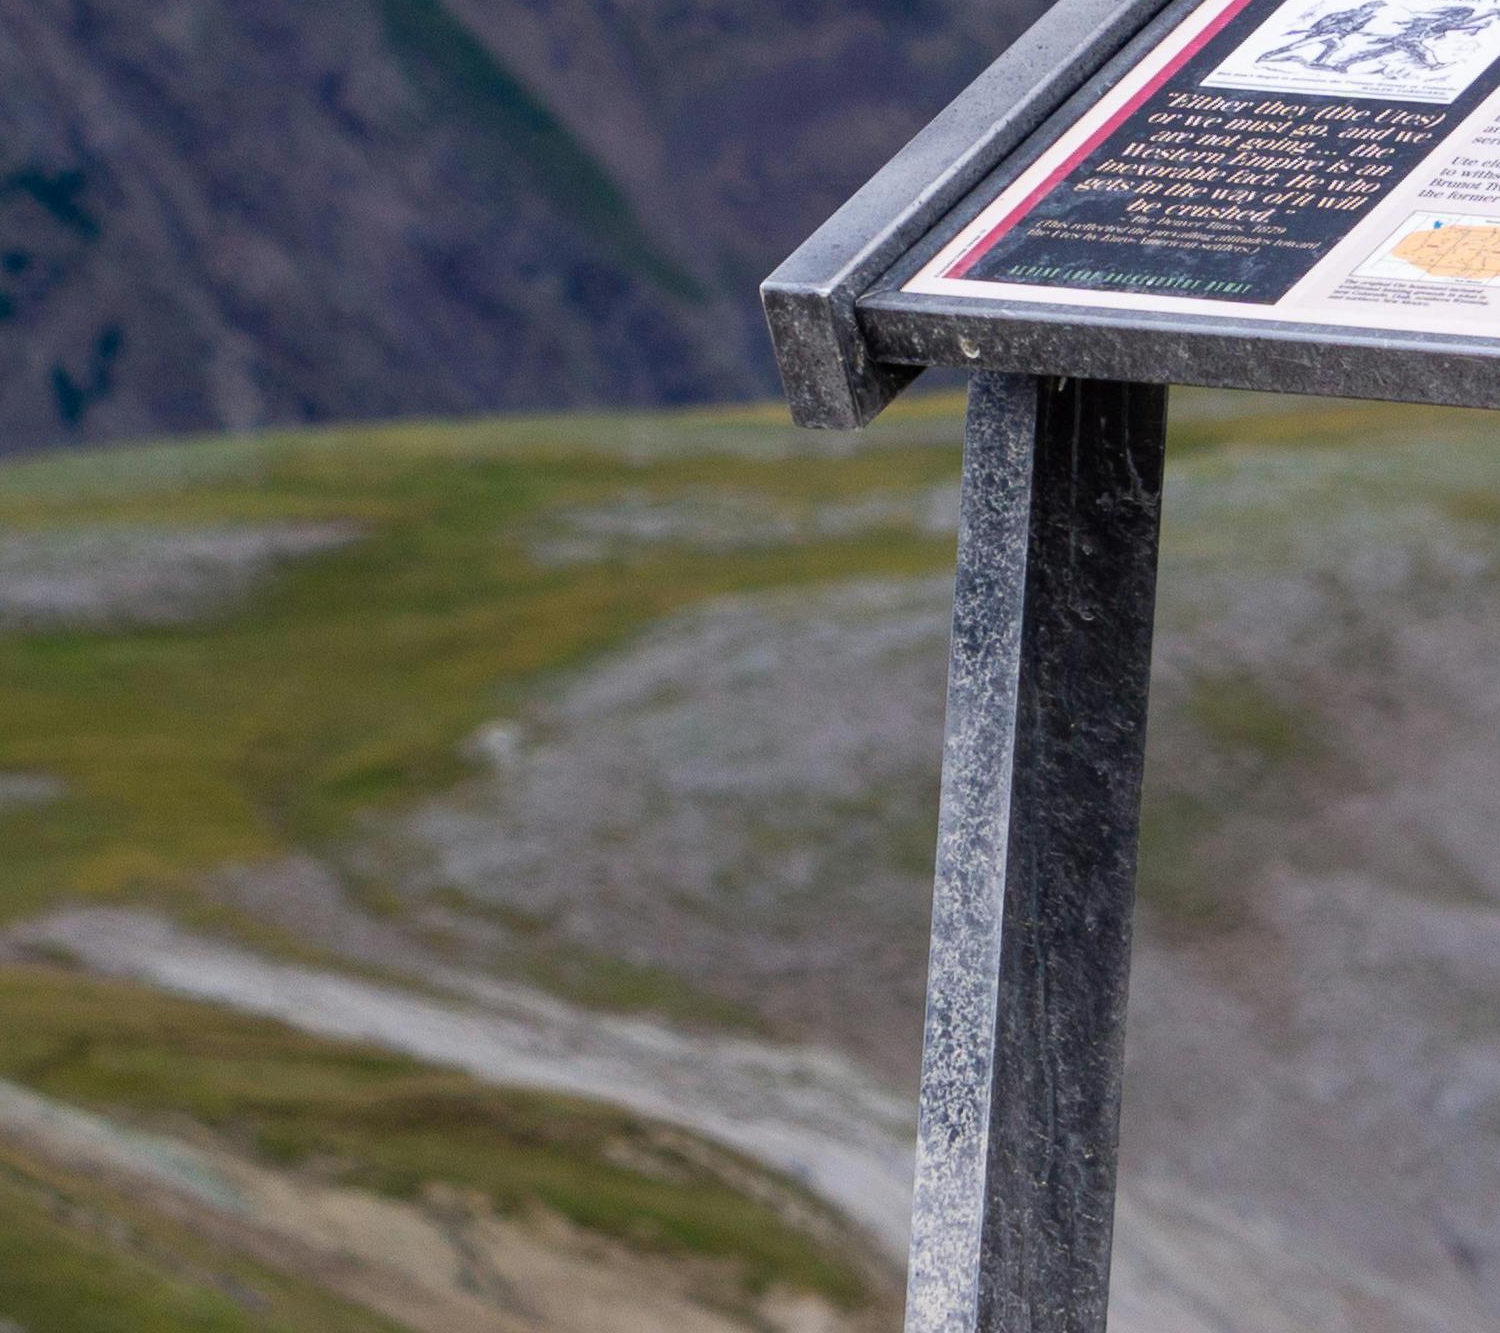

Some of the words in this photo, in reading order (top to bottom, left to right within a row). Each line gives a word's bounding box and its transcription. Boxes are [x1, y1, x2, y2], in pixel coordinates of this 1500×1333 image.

[1148, 113, 1183, 124] or
[1184, 115, 1223, 128] we
[1224, 119, 1293, 134] must
[1337, 127, 1396, 141] and
[1394, 131, 1433, 144] we
[1254, 101, 1315, 117] they
[1314, 105, 1371, 121] (the
[1374, 109, 1446, 129] Utes)
[1149, 131, 1195, 144] are
[1195, 134, 1241, 148] not
[1236, 137, 1316, 155] going
[1348, 143, 1395, 159] the
[1122, 142, 1226, 164] Western
[1226, 151, 1325, 171] Empire
[1326, 159, 1354, 173] is
[1355, 164, 1393, 177] an
[1439, 168, 1457, 177] to
[1451, 156, 1479, 166] Ute
[1096, 159, 1227, 181] inexorable
[1284, 174, 1325, 189] He
[1328, 178, 1381, 193] who
[1429, 178, 1483, 190] Brunot
[1073, 178, 1135, 195] gets
[1133, 180, 1164, 195] in
[1163, 183, 1208, 198] the
[1211, 189, 1264, 205] way
[1262, 191, 1300, 205] of
[1291, 192, 1316, 207] it
[1317, 196, 1369, 211] will
[1126, 198, 1162, 213] be
[1418, 189, 1445, 199] the
